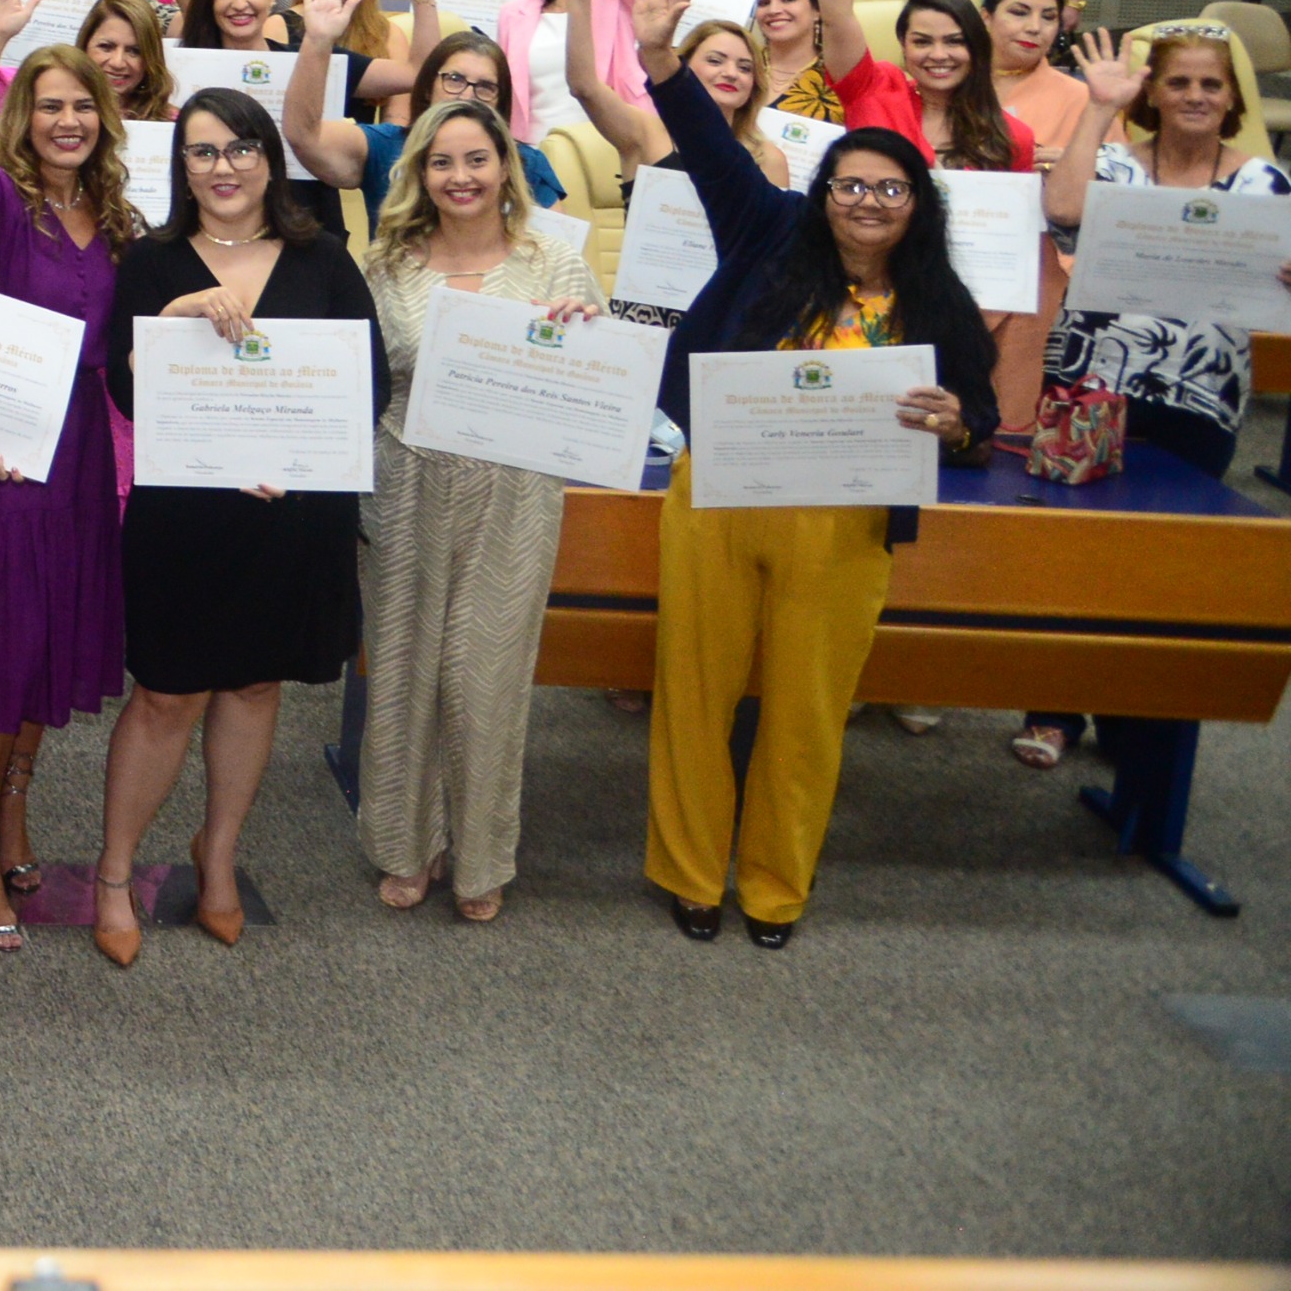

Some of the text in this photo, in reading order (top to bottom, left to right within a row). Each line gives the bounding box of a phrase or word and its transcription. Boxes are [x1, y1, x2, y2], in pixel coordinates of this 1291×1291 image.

[168, 363, 337, 378] Diploma de Honra ao Mérito
[859, 392, 899, 403] Mérit
[191, 403, 230, 413] Gabriela
[275, 405, 313, 415] Miranda
